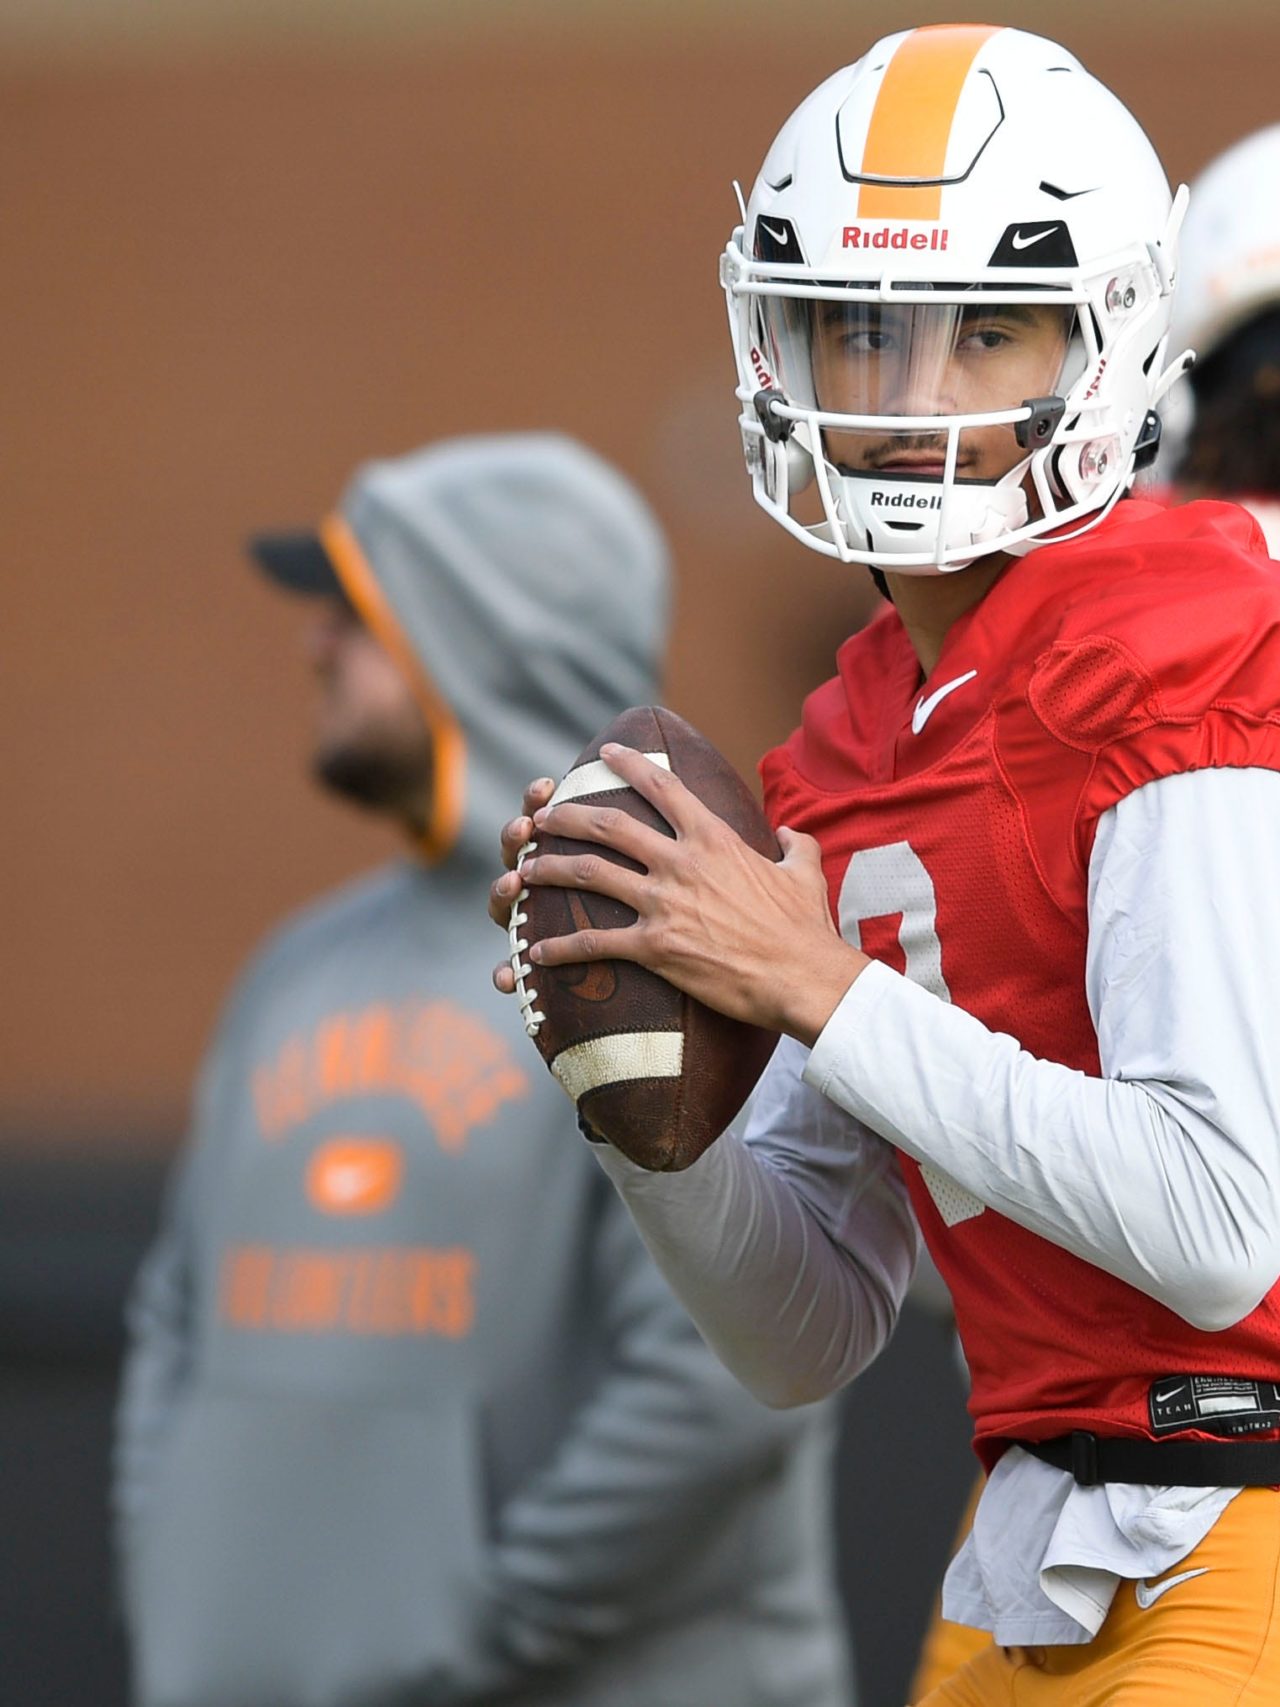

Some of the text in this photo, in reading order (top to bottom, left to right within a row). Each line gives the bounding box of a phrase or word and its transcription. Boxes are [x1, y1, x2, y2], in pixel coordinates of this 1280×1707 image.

[842, 226, 949, 251] Riddell
[871, 491, 942, 510] Riddell
[1157, 1403, 1192, 1416] TEAM
